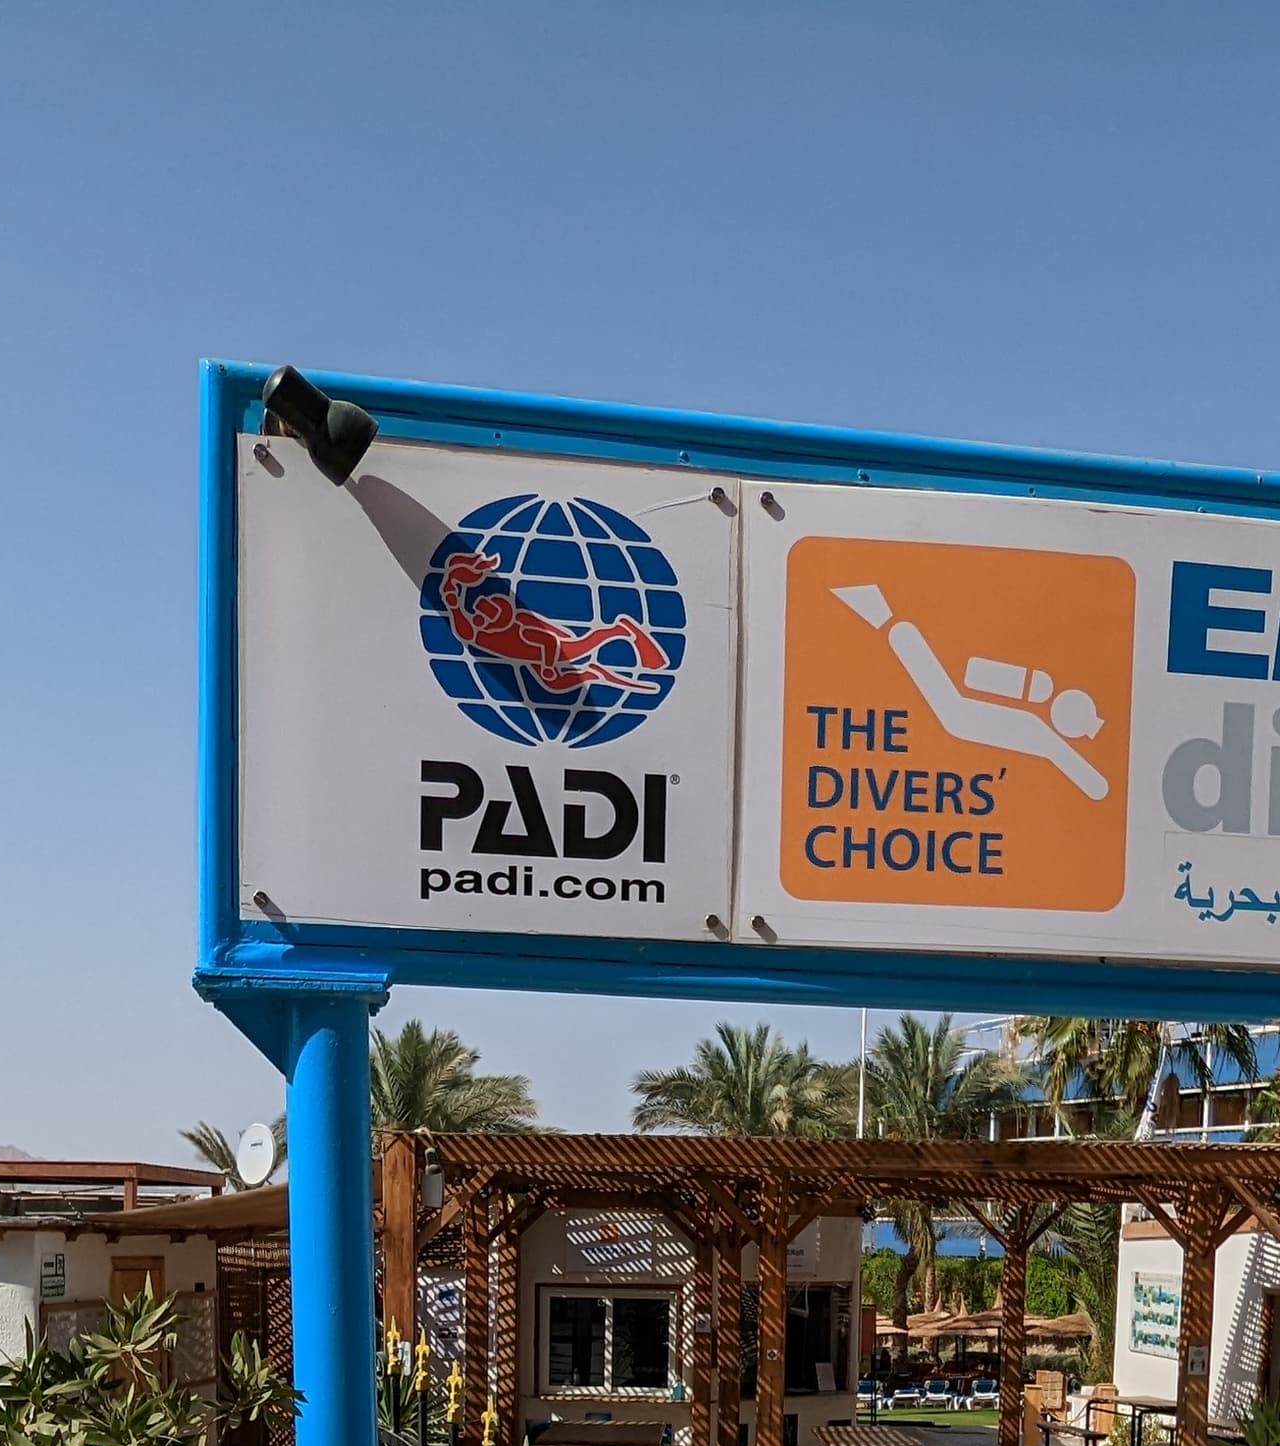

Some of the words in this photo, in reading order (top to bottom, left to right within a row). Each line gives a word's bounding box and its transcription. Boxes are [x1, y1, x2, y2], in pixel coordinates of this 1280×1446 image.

[806, 705, 910, 754] THE
[419, 759, 668, 863] PADI
[804, 825, 1005, 876] CHOICE
[420, 864, 667, 904] padi.com
